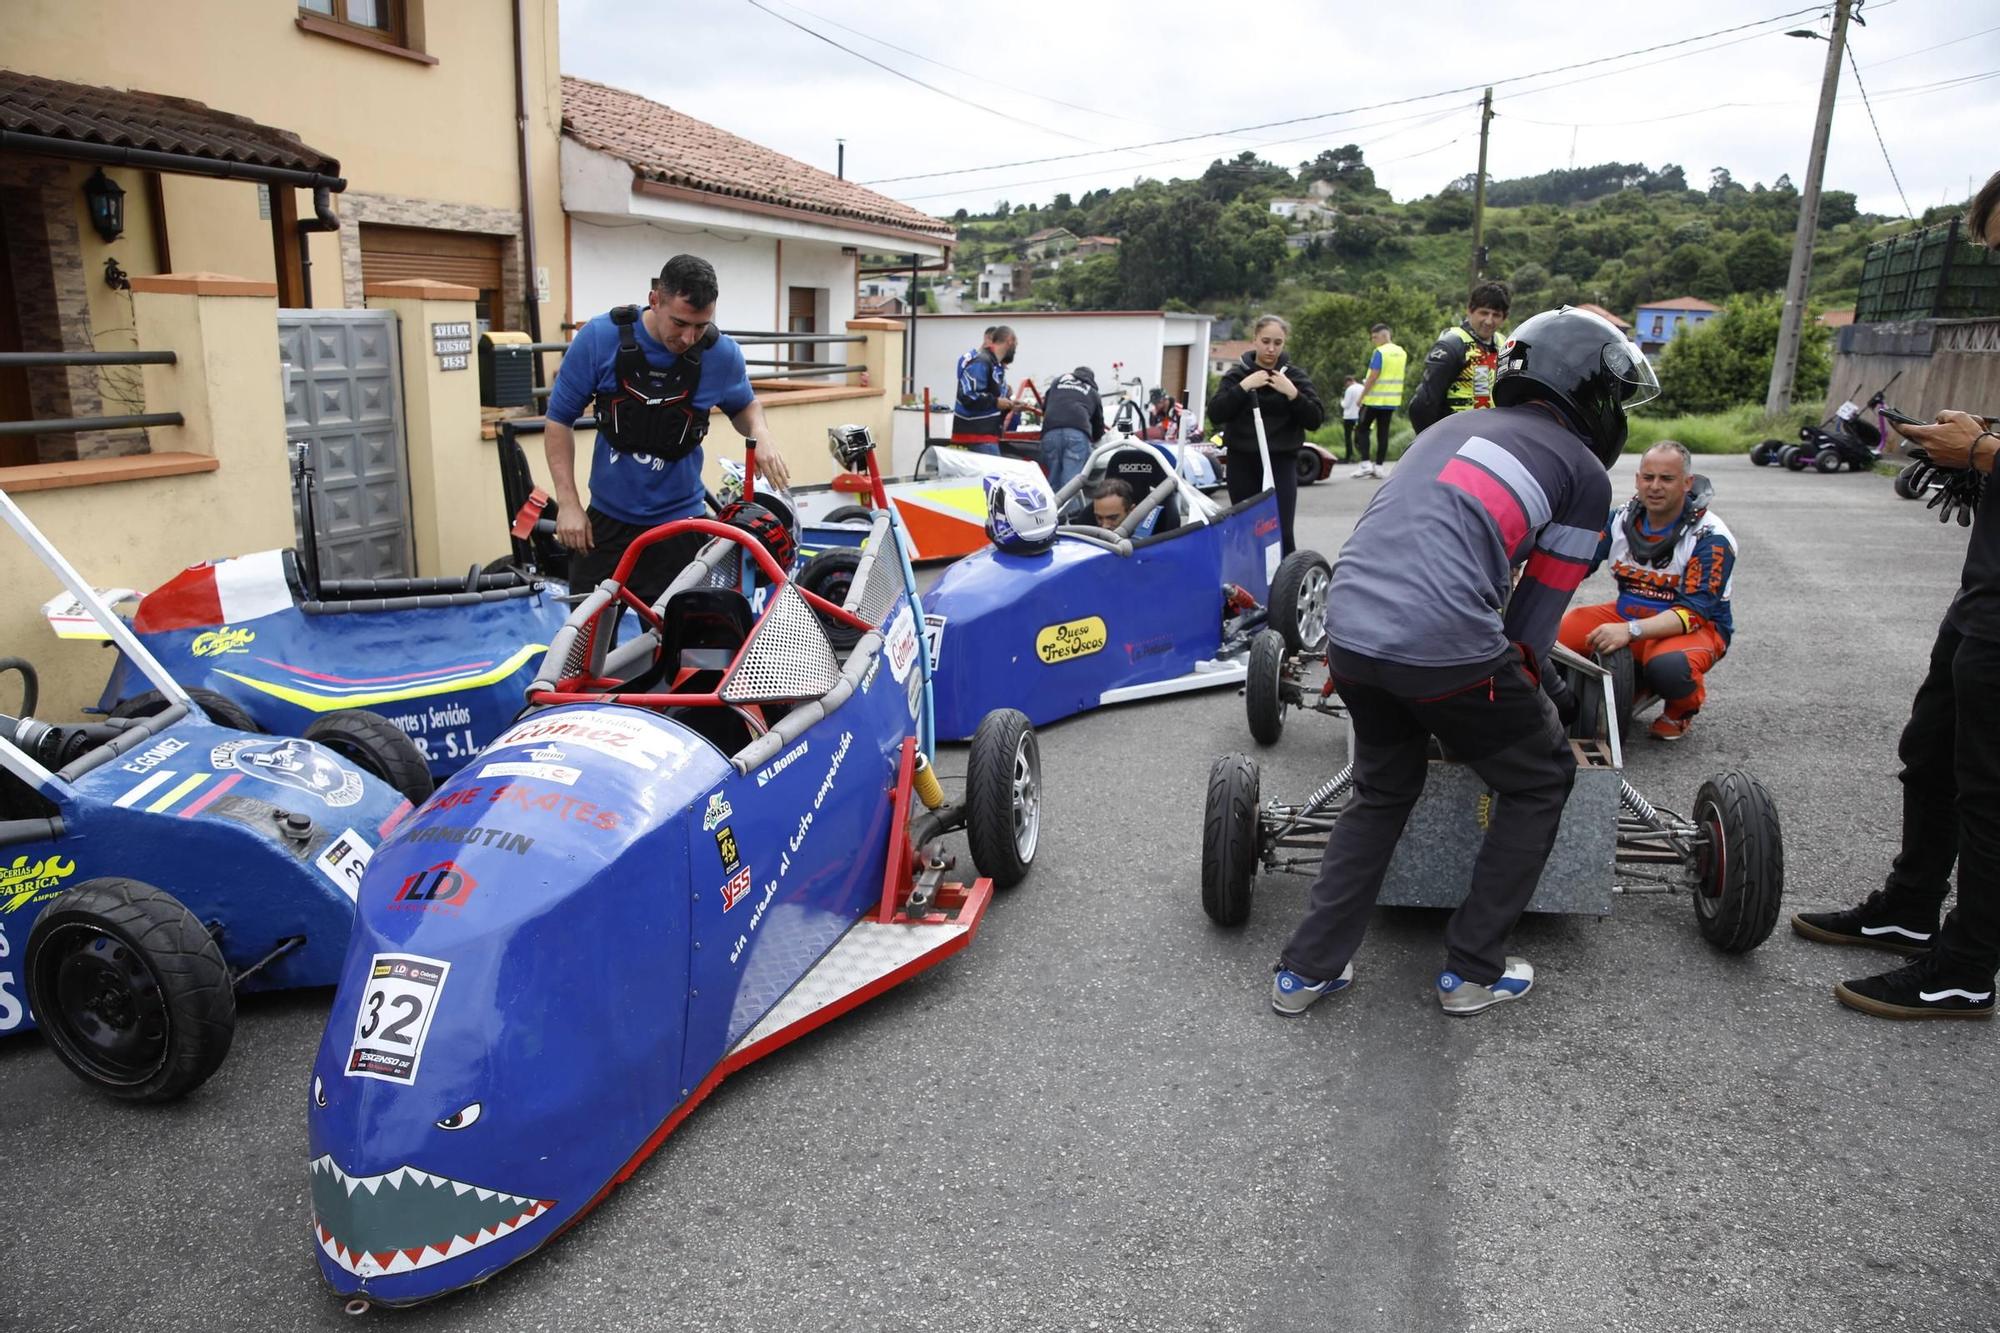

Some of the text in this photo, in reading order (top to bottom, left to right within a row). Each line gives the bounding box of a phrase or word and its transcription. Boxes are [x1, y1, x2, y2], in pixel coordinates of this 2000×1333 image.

[437, 324, 468, 336] VILLA
[438, 340, 469, 352] BUSTO
[446, 357, 464, 368] 152
[1118, 463, 1152, 472] sparco
[1056, 625, 1089, 643] Queso
[1042, 637, 1103, 661] Tres Oscos
[420, 713, 428, 734] y
[428, 702, 471, 728] Servicios
[505, 721, 636, 749] Gómez
[487, 784, 624, 831] SKATES
[730, 934, 747, 964] sin
[750, 879, 777, 931] miedo
[780, 852, 791, 877] al
[814, 731, 853, 809] competición
[404, 870, 463, 901] LD
[361, 991, 423, 1046] 32
